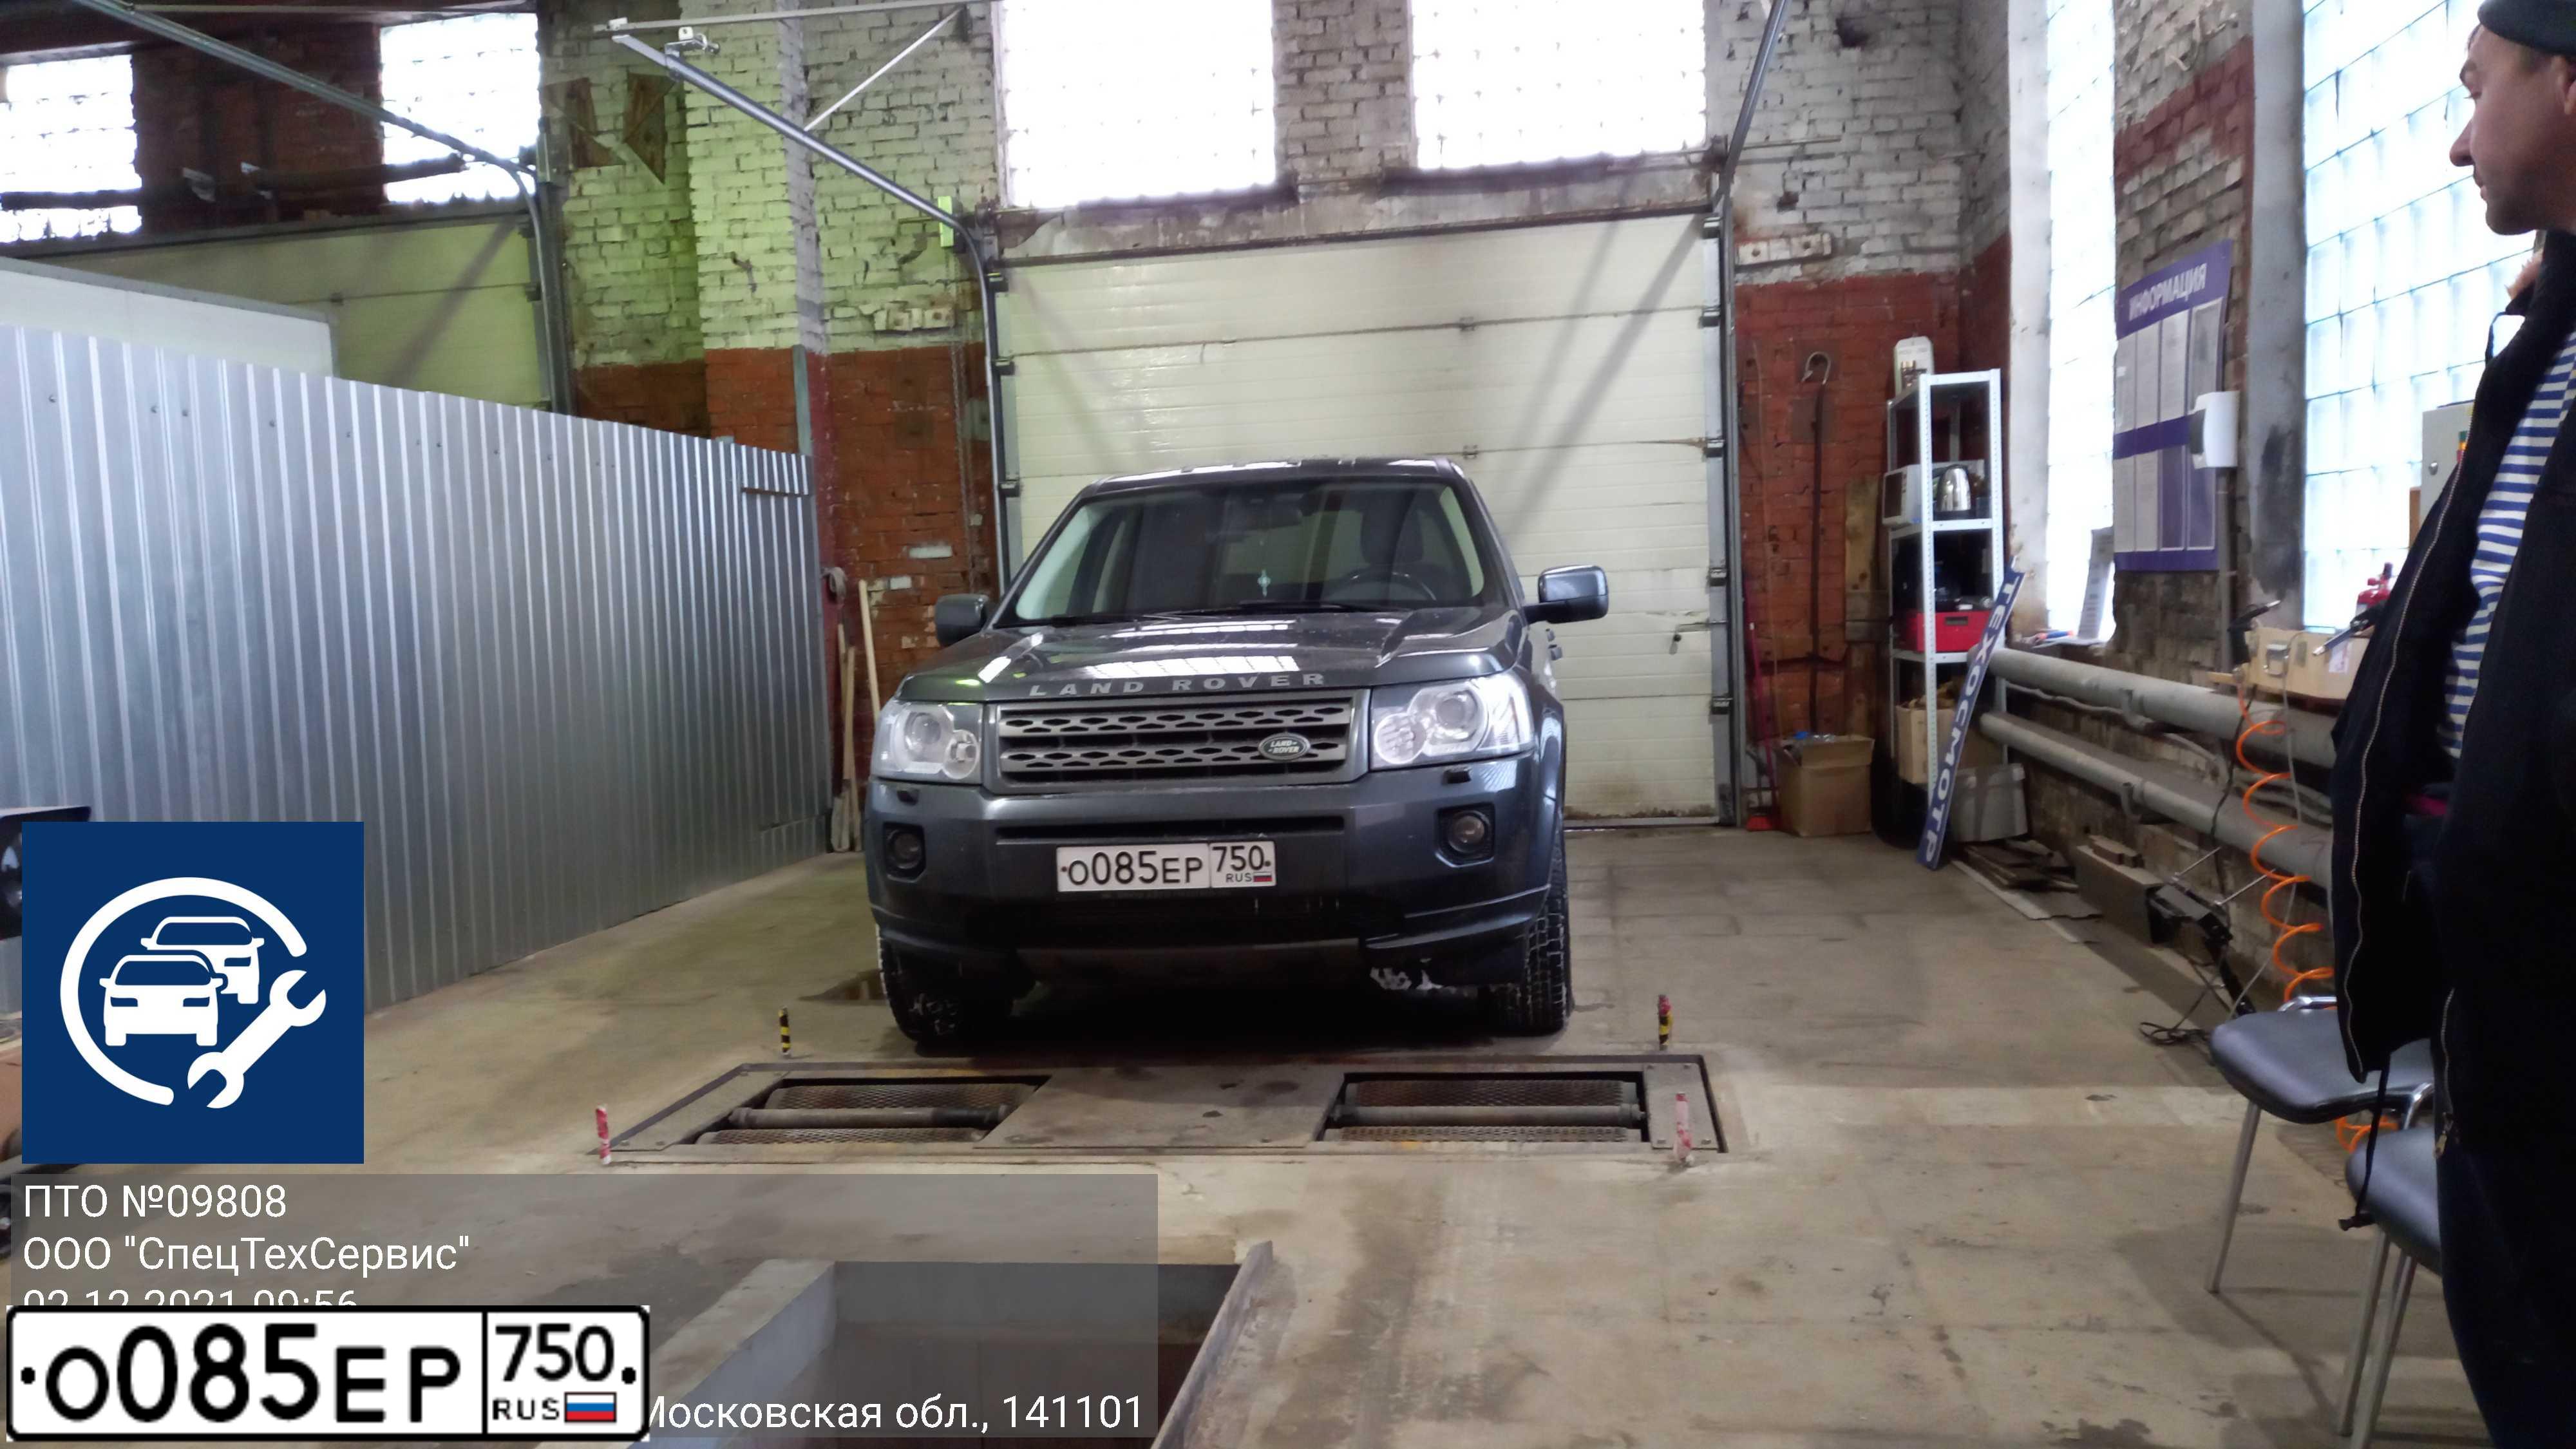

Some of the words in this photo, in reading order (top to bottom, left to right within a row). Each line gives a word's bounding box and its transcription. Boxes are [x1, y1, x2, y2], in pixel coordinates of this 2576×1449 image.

[2129, 263, 2207, 321] ИНФОРМАЦИЯ
[1030, 681, 1144, 696] LAND
[1172, 672, 1325, 691] ROVER
[1926, 575, 2020, 862] ТЕХОСМОТР
[1212, 846, 1264, 872] 750
[1226, 873, 1252, 883] RUS
